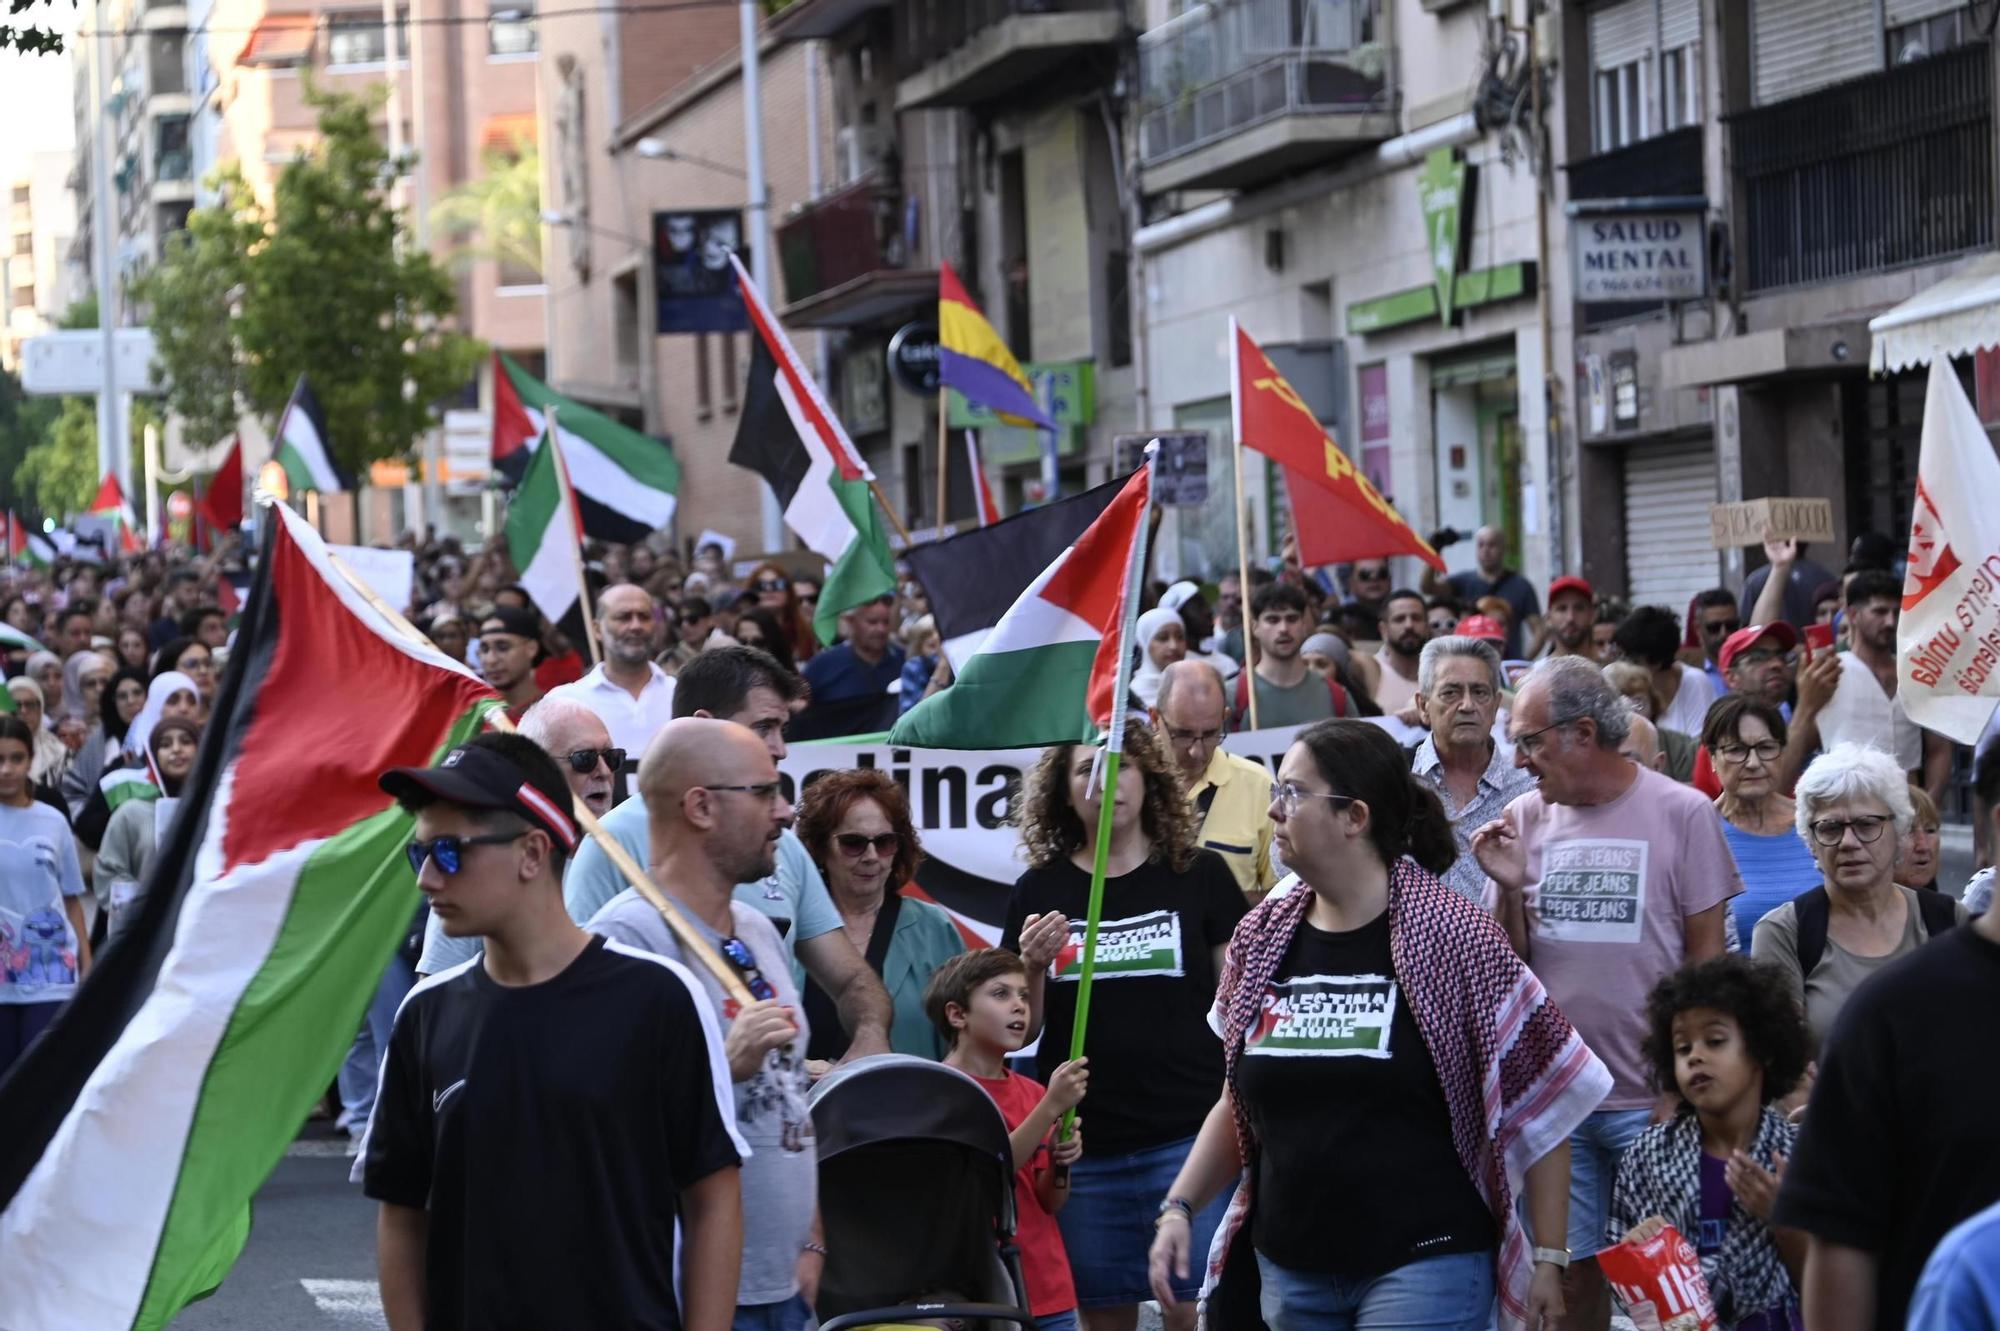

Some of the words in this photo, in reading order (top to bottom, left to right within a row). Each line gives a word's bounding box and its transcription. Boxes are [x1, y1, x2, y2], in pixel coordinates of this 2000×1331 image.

[1592, 220, 1682, 244] SALUD
[1584, 247, 1692, 271] MENTAL
[1586, 848, 1633, 868] JEANS
[1545, 874, 1582, 893] PEPE
[1583, 874, 1631, 893] JEANS
[1545, 899, 1580, 918] PEPE
[1581, 899, 1628, 919] JEANS
[1261, 991, 1386, 1016] PALESTINA
[1271, 1015, 1357, 1039] LLIURE
